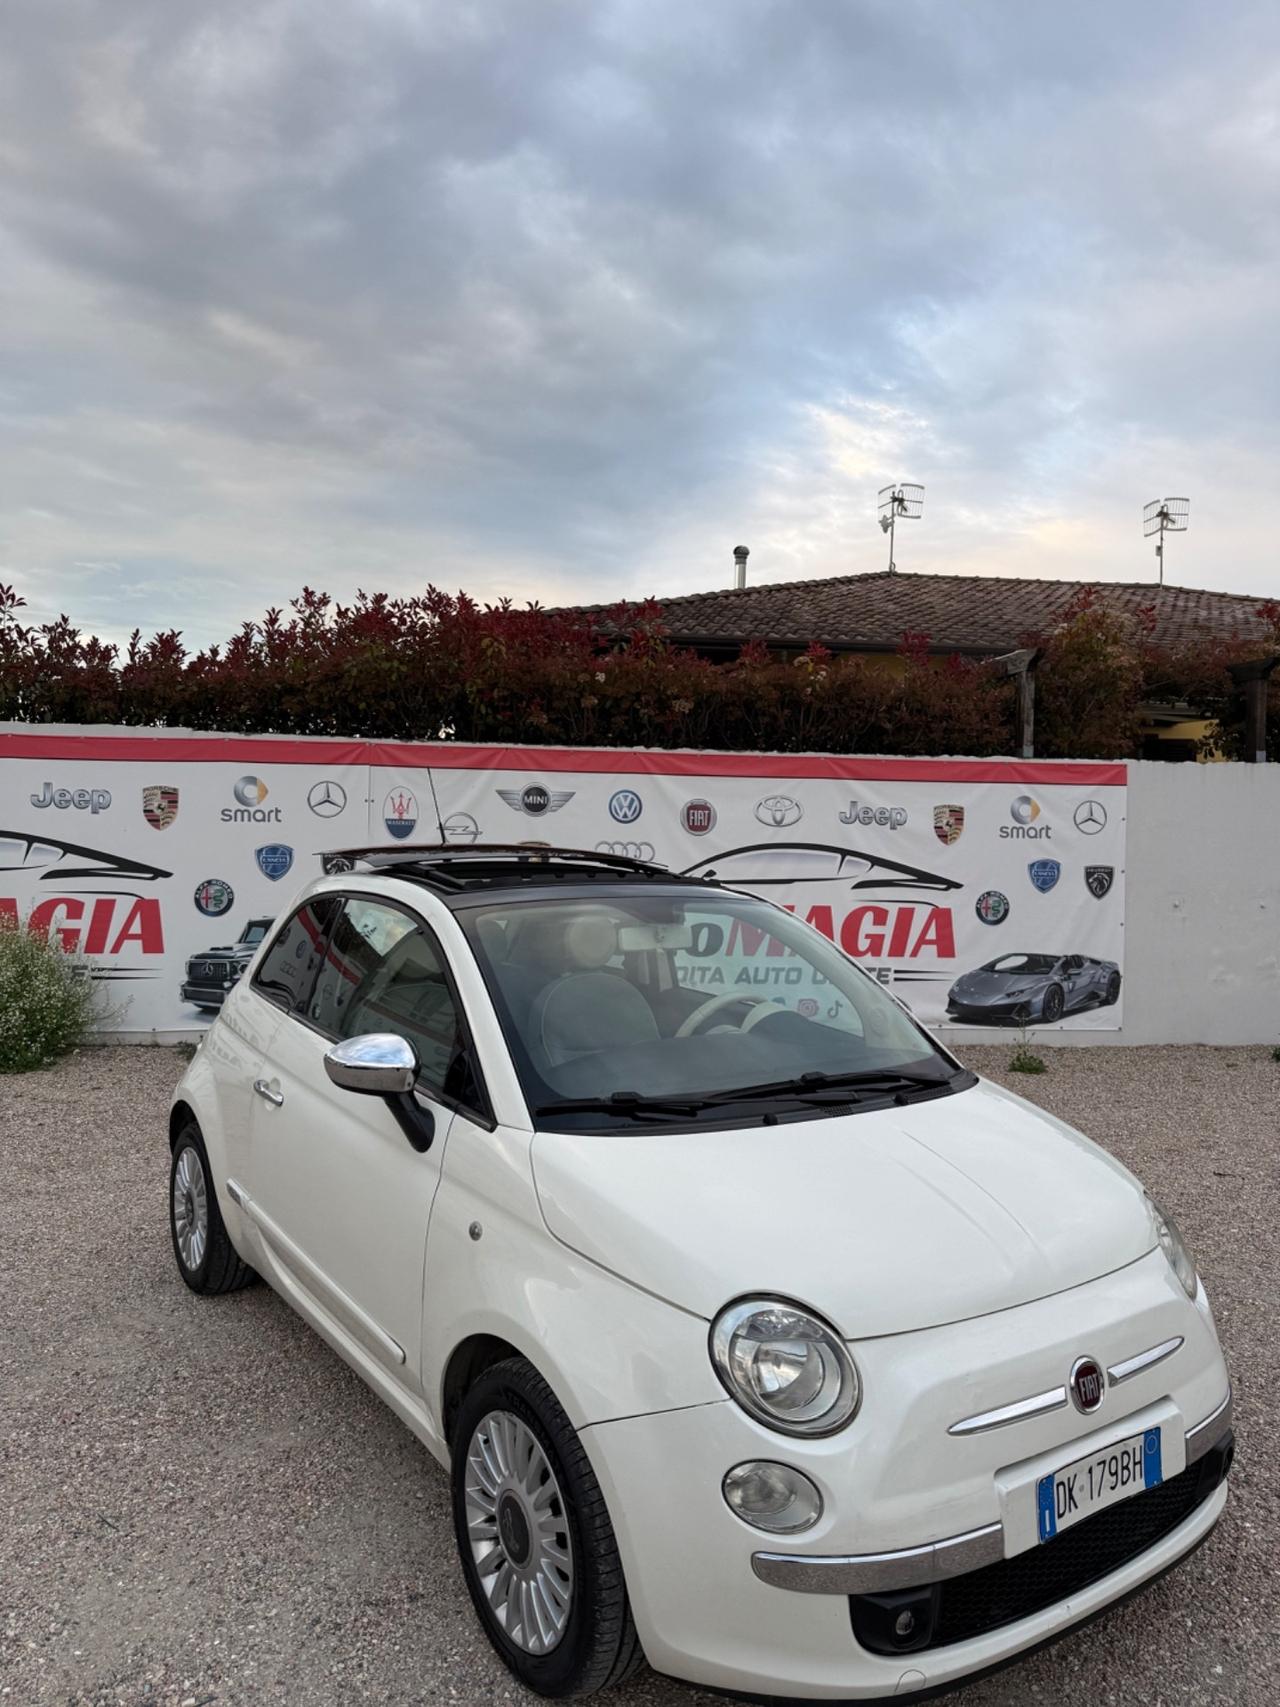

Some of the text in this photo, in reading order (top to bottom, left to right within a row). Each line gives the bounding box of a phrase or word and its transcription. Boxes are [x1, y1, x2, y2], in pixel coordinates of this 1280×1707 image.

[30, 782, 112, 814] Jeep
[524, 795, 548, 804] MINI
[220, 806, 282, 823] smart
[688, 809, 710, 826] FIAT
[839, 801, 908, 830] Jeep
[1000, 824, 1052, 839] smart
[735, 966, 802, 985] AUTO
[1078, 1373, 1100, 1402] FIAT
[1055, 1444, 1144, 1519] DK 179BH
